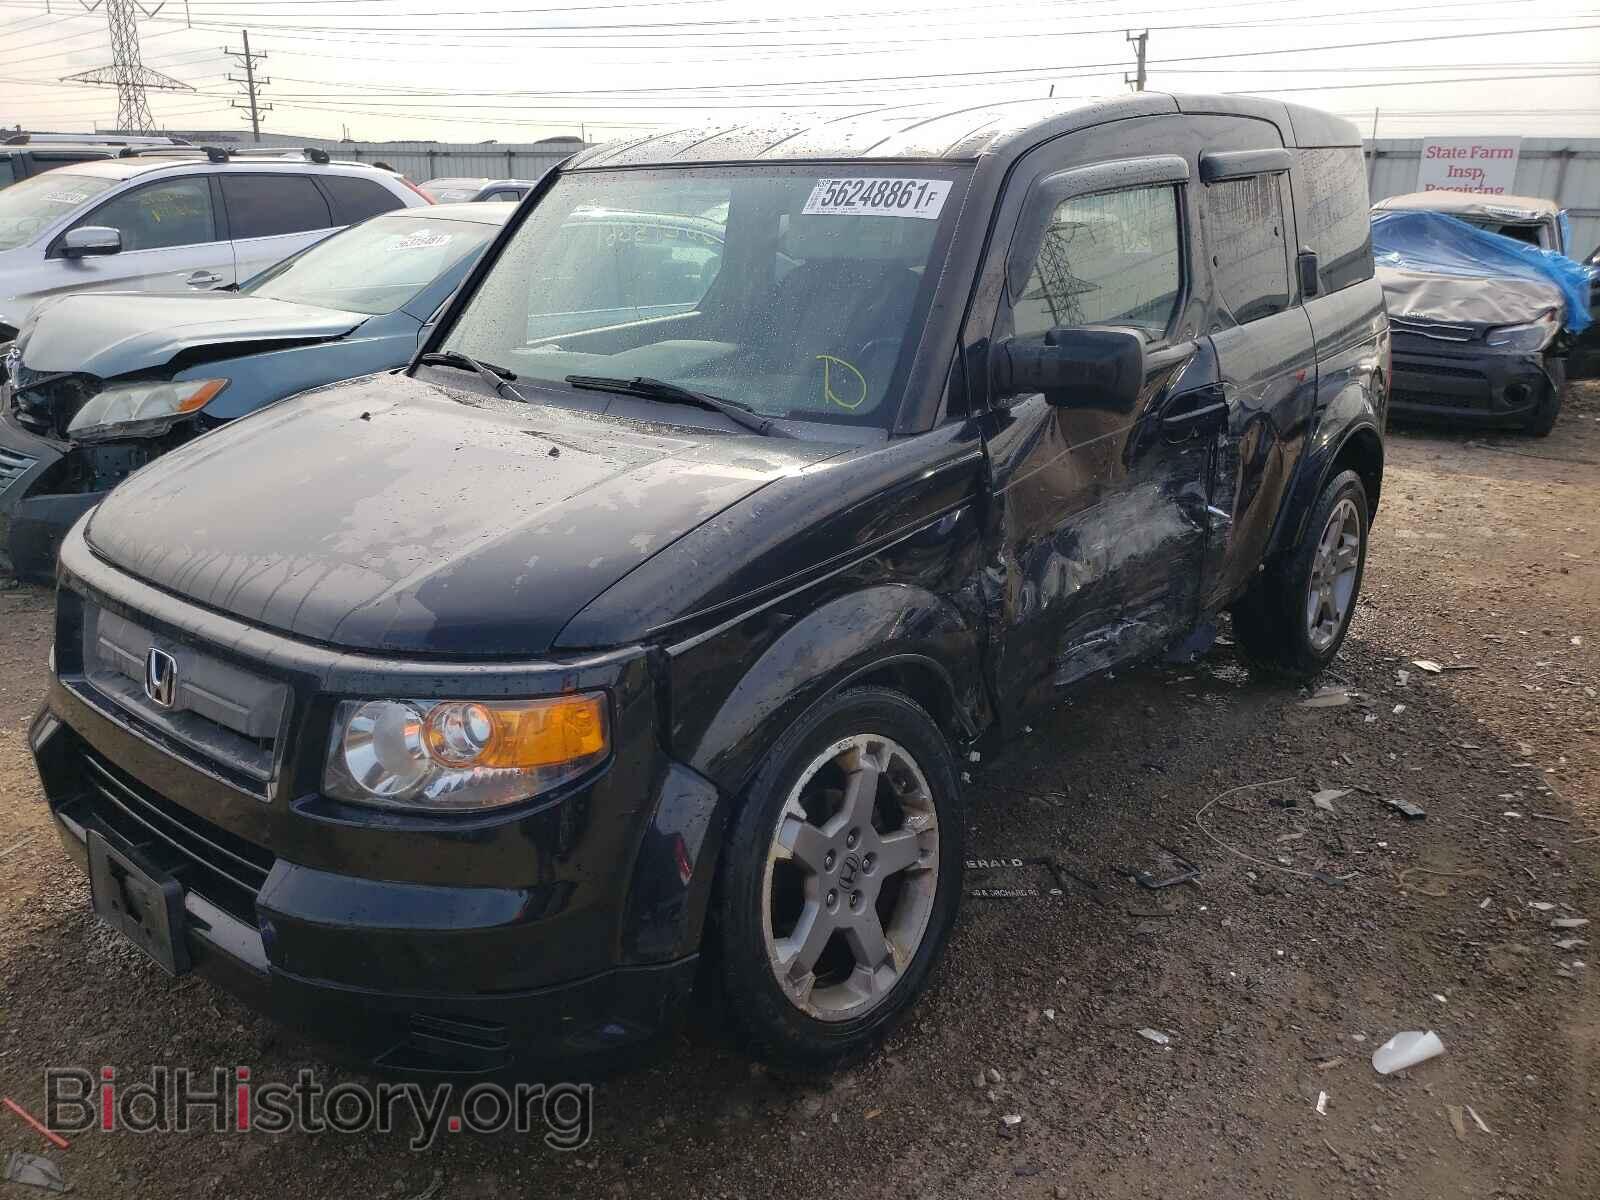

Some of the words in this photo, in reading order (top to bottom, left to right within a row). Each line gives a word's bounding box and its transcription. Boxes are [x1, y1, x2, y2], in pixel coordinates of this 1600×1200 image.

[1425, 145, 1466, 159] State
[1470, 145, 1514, 159] Farm
[820, 180, 930, 209] 56248861
[924, 191, 938, 207] F
[816, 354, 867, 410] D
